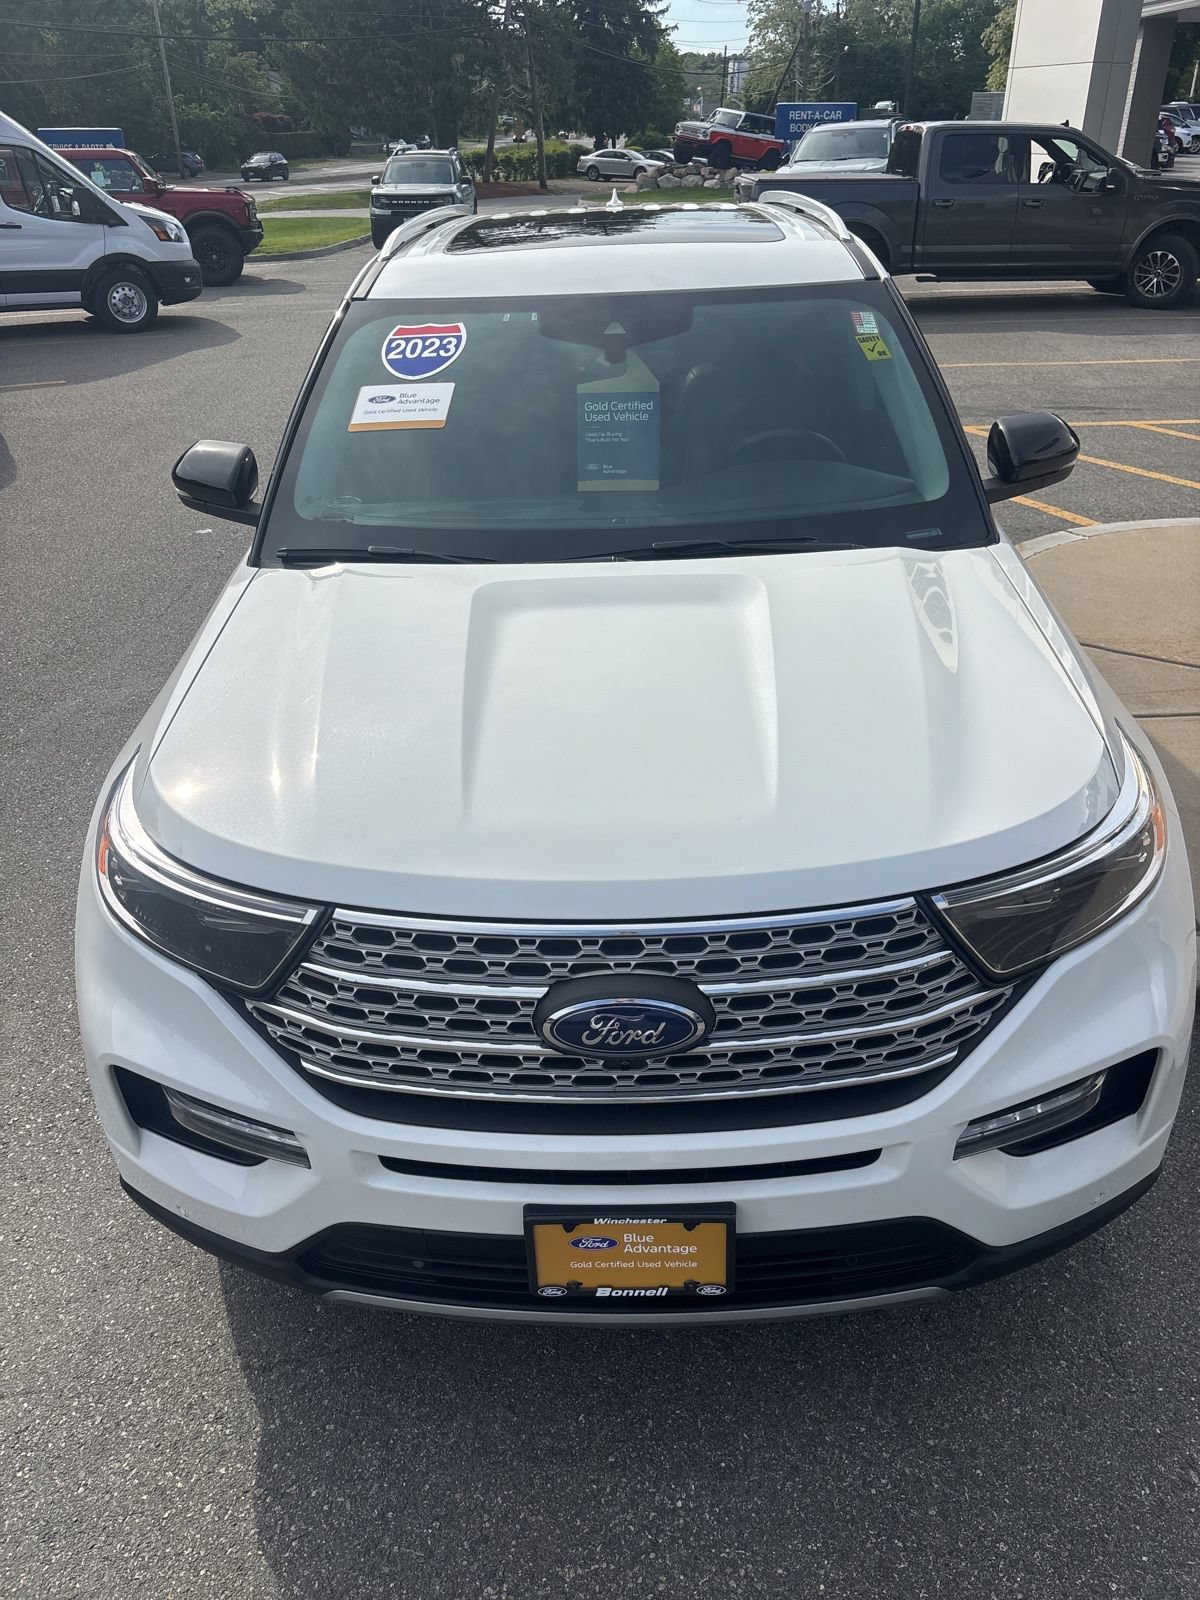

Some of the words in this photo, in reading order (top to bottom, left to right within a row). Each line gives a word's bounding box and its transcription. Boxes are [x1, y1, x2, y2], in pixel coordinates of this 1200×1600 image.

[789, 110, 842, 120] RENT-A-CAR
[789, 123, 813, 133] BODY
[387, 337, 458, 360] 2023
[377, 407, 401, 415] Certified
[584, 401, 609, 412] Gold
[610, 400, 654, 411] Certified
[584, 412, 611, 422] Used
[613, 411, 649, 421] Vehicle
[581, 1012, 666, 1046] Ford
[593, 1217, 667, 1225] Winchester
[624, 1233, 654, 1243] Blue
[578, 1238, 610, 1249] Ford
[623, 1244, 698, 1255] Advantage
[570, 1261, 592, 1269] Gold
[595, 1260, 635, 1269] Certified
[637, 1260, 662, 1268] Used
[664, 1260, 698, 1268] Vehicle
[542, 1287, 564, 1296] Ford
[595, 1287, 668, 1297] Bonnell
[701, 1286, 722, 1295] Ford
